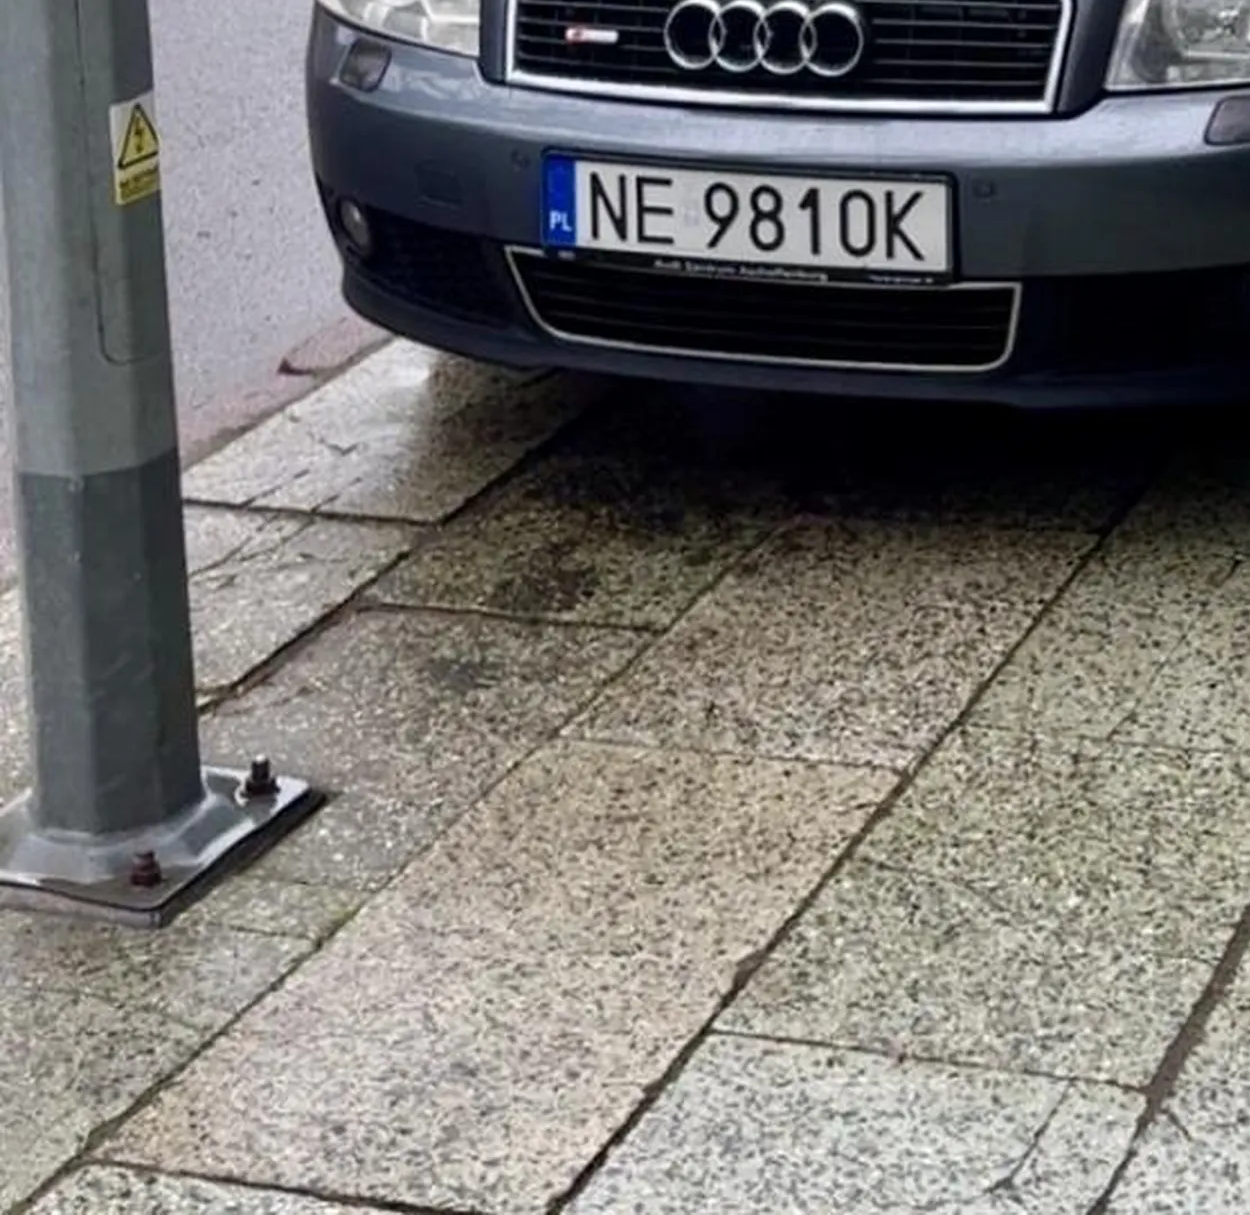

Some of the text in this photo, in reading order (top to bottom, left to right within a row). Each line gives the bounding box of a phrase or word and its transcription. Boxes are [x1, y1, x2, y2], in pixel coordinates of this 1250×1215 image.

[549, 210, 573, 232] PL
[590, 171, 926, 262] NE 9810K
